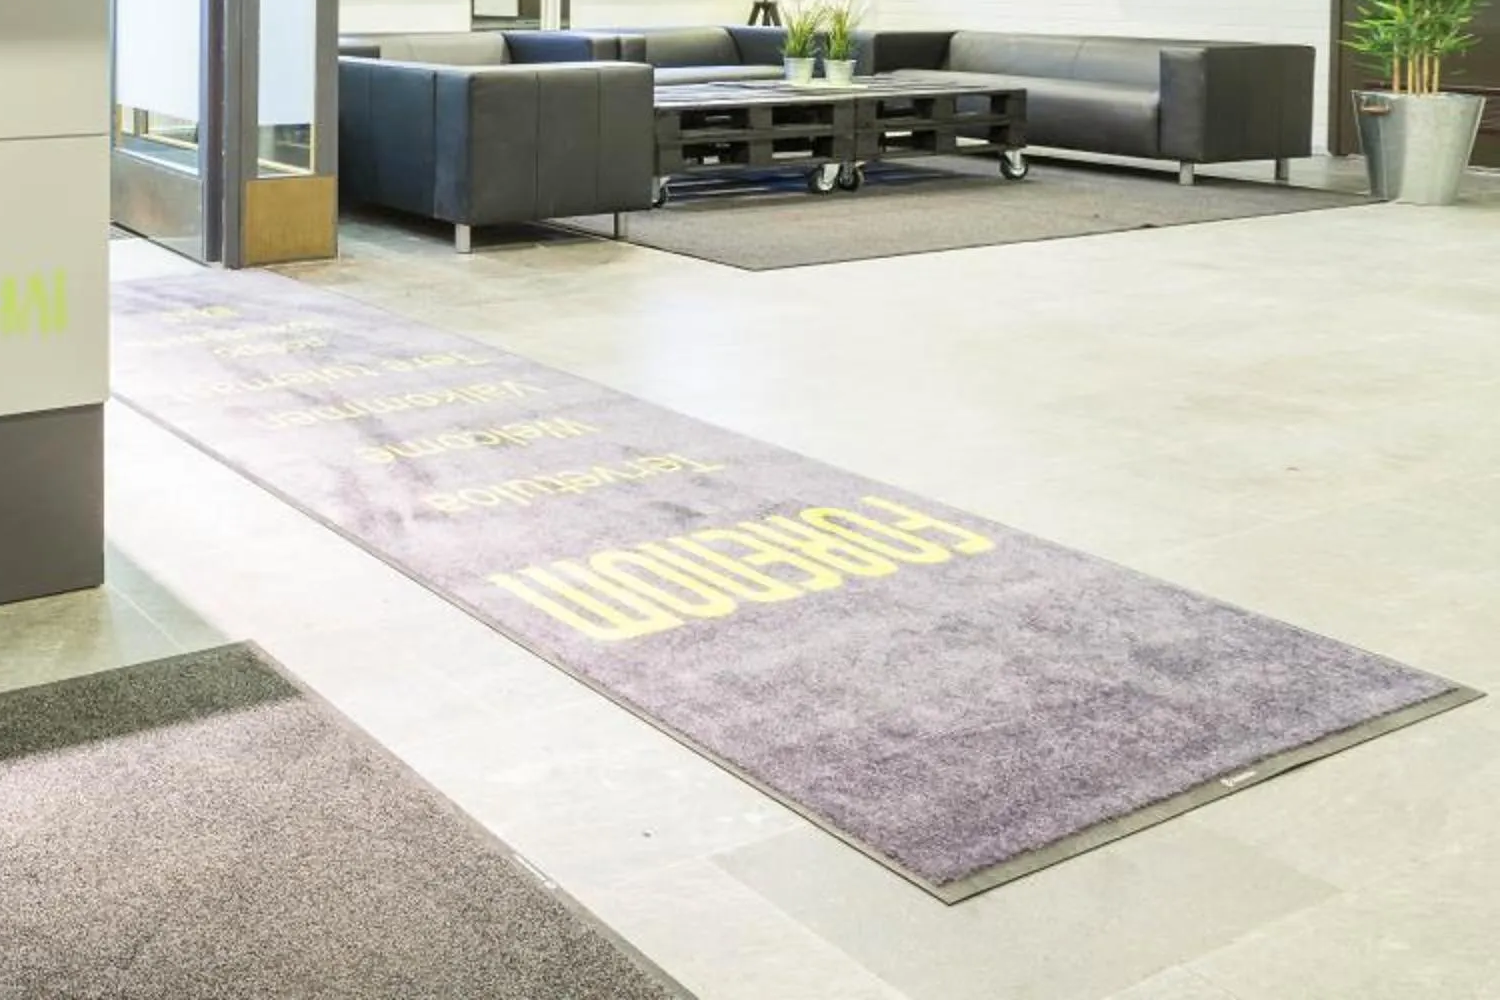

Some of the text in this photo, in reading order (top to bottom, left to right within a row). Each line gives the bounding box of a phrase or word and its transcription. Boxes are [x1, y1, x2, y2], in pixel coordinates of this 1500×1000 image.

[357, 416, 599, 464] Welcome
[430, 453, 726, 513] Tervetuloa
[489, 496, 996, 642] FORENOM
